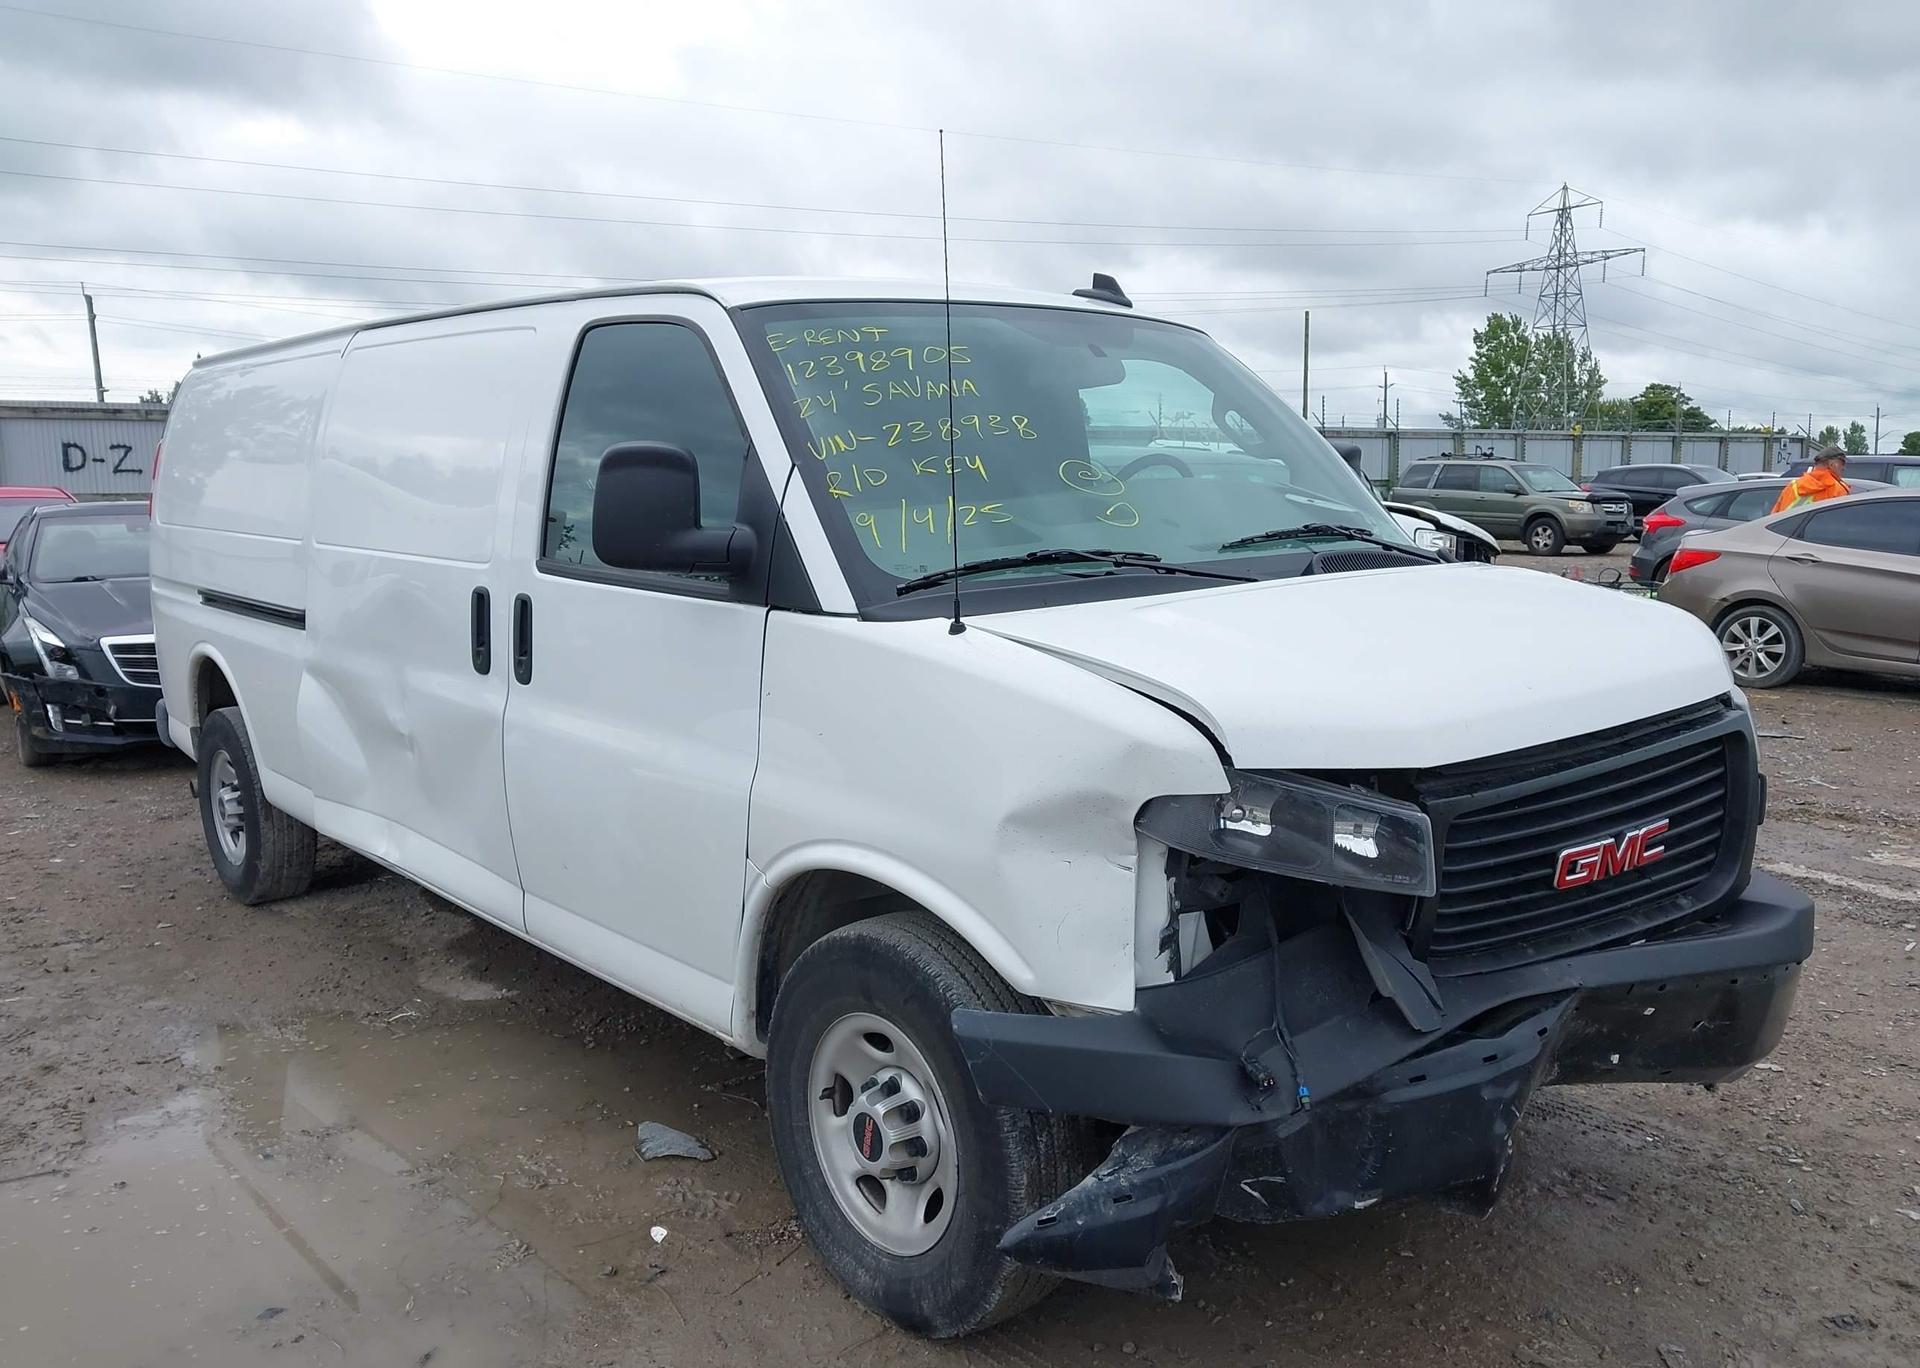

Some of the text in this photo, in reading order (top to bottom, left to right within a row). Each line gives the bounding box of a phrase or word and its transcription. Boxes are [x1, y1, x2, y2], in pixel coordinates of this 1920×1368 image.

[766, 326, 888, 352] E-RENT
[786, 345, 972, 386] 12398905
[862, 375, 980, 406] SAVANA
[61, 441, 143, 475] D-Z
[911, 455, 989, 482] KEY
[1553, 818, 1670, 890] GMC
[862, 1116, 874, 1159] GMC
